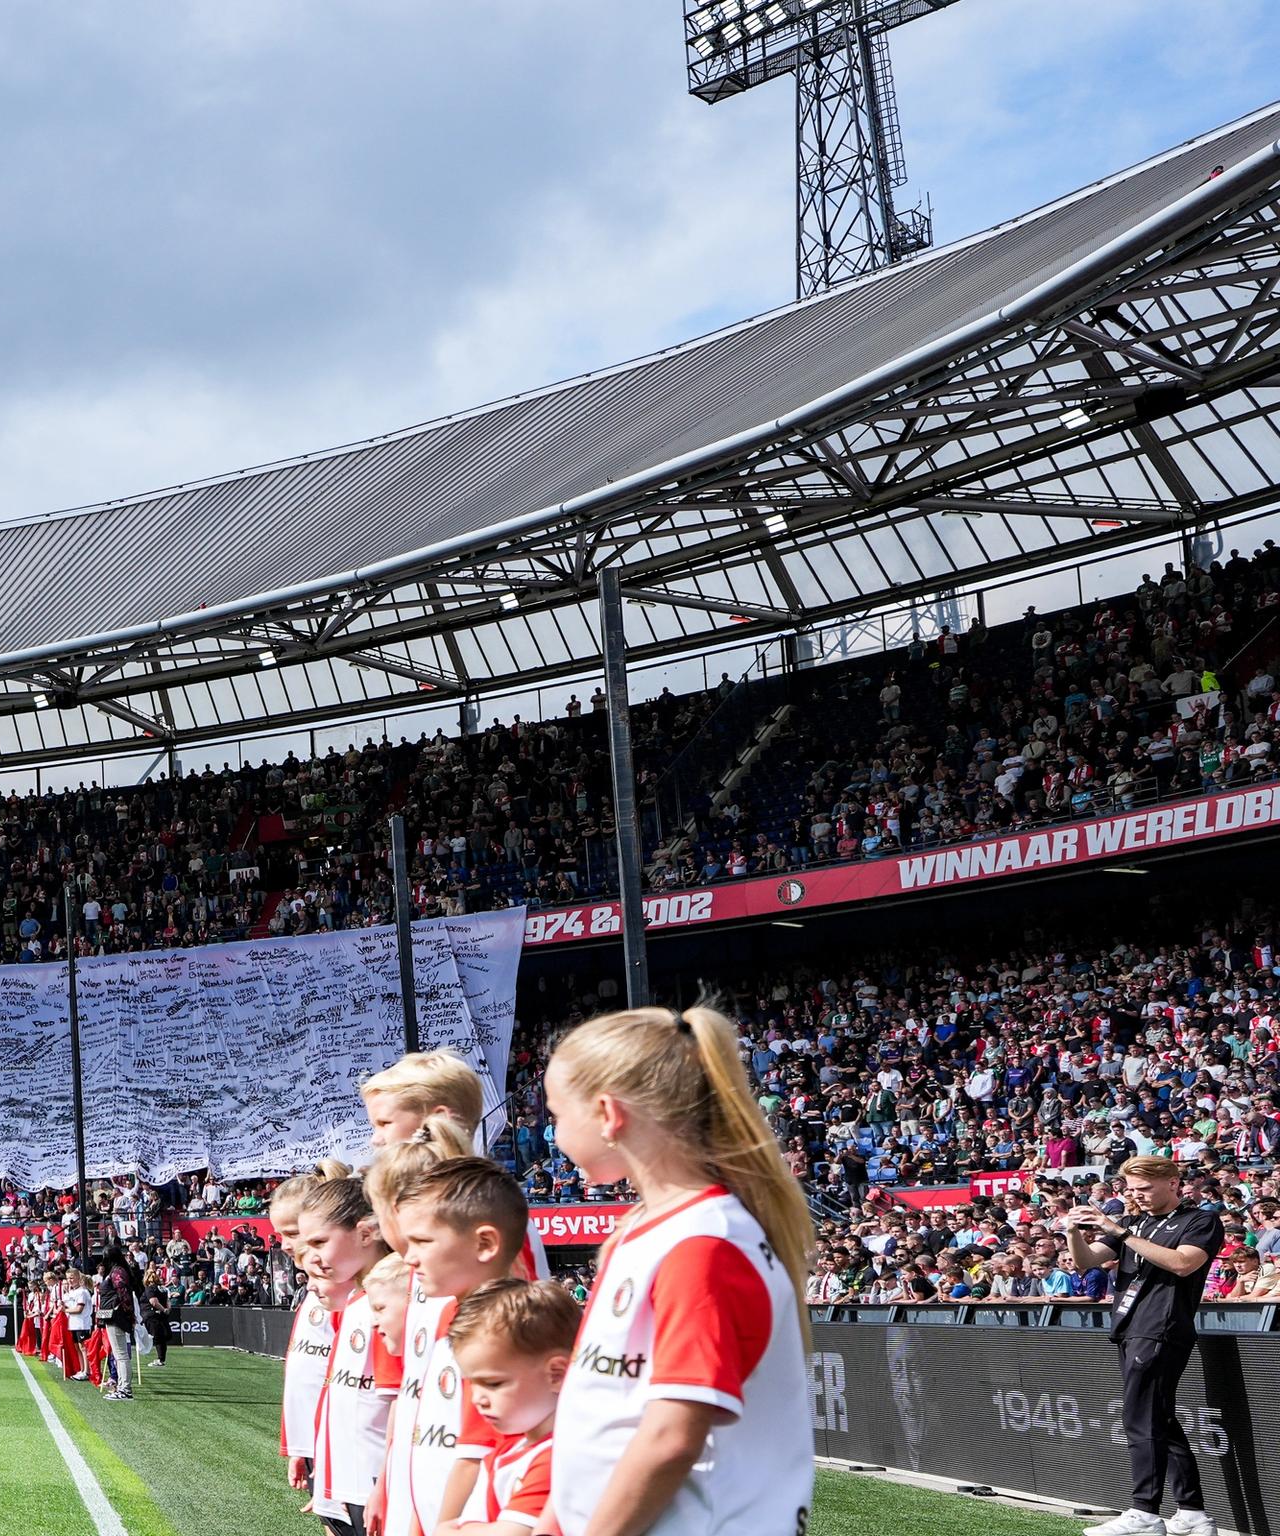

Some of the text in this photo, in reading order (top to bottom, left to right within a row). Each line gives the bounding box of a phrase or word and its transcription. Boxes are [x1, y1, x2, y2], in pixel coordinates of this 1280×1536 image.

[897, 828, 1079, 889] WINNAAR
[525, 909, 584, 943] 974
[133, 1057, 166, 1068] HANS
[293, 1339, 331, 1357] Markt
[574, 1343, 646, 1378] Markt
[332, 1369, 374, 1390] Markt
[992, 1389, 1230, 1457] 1948-225
